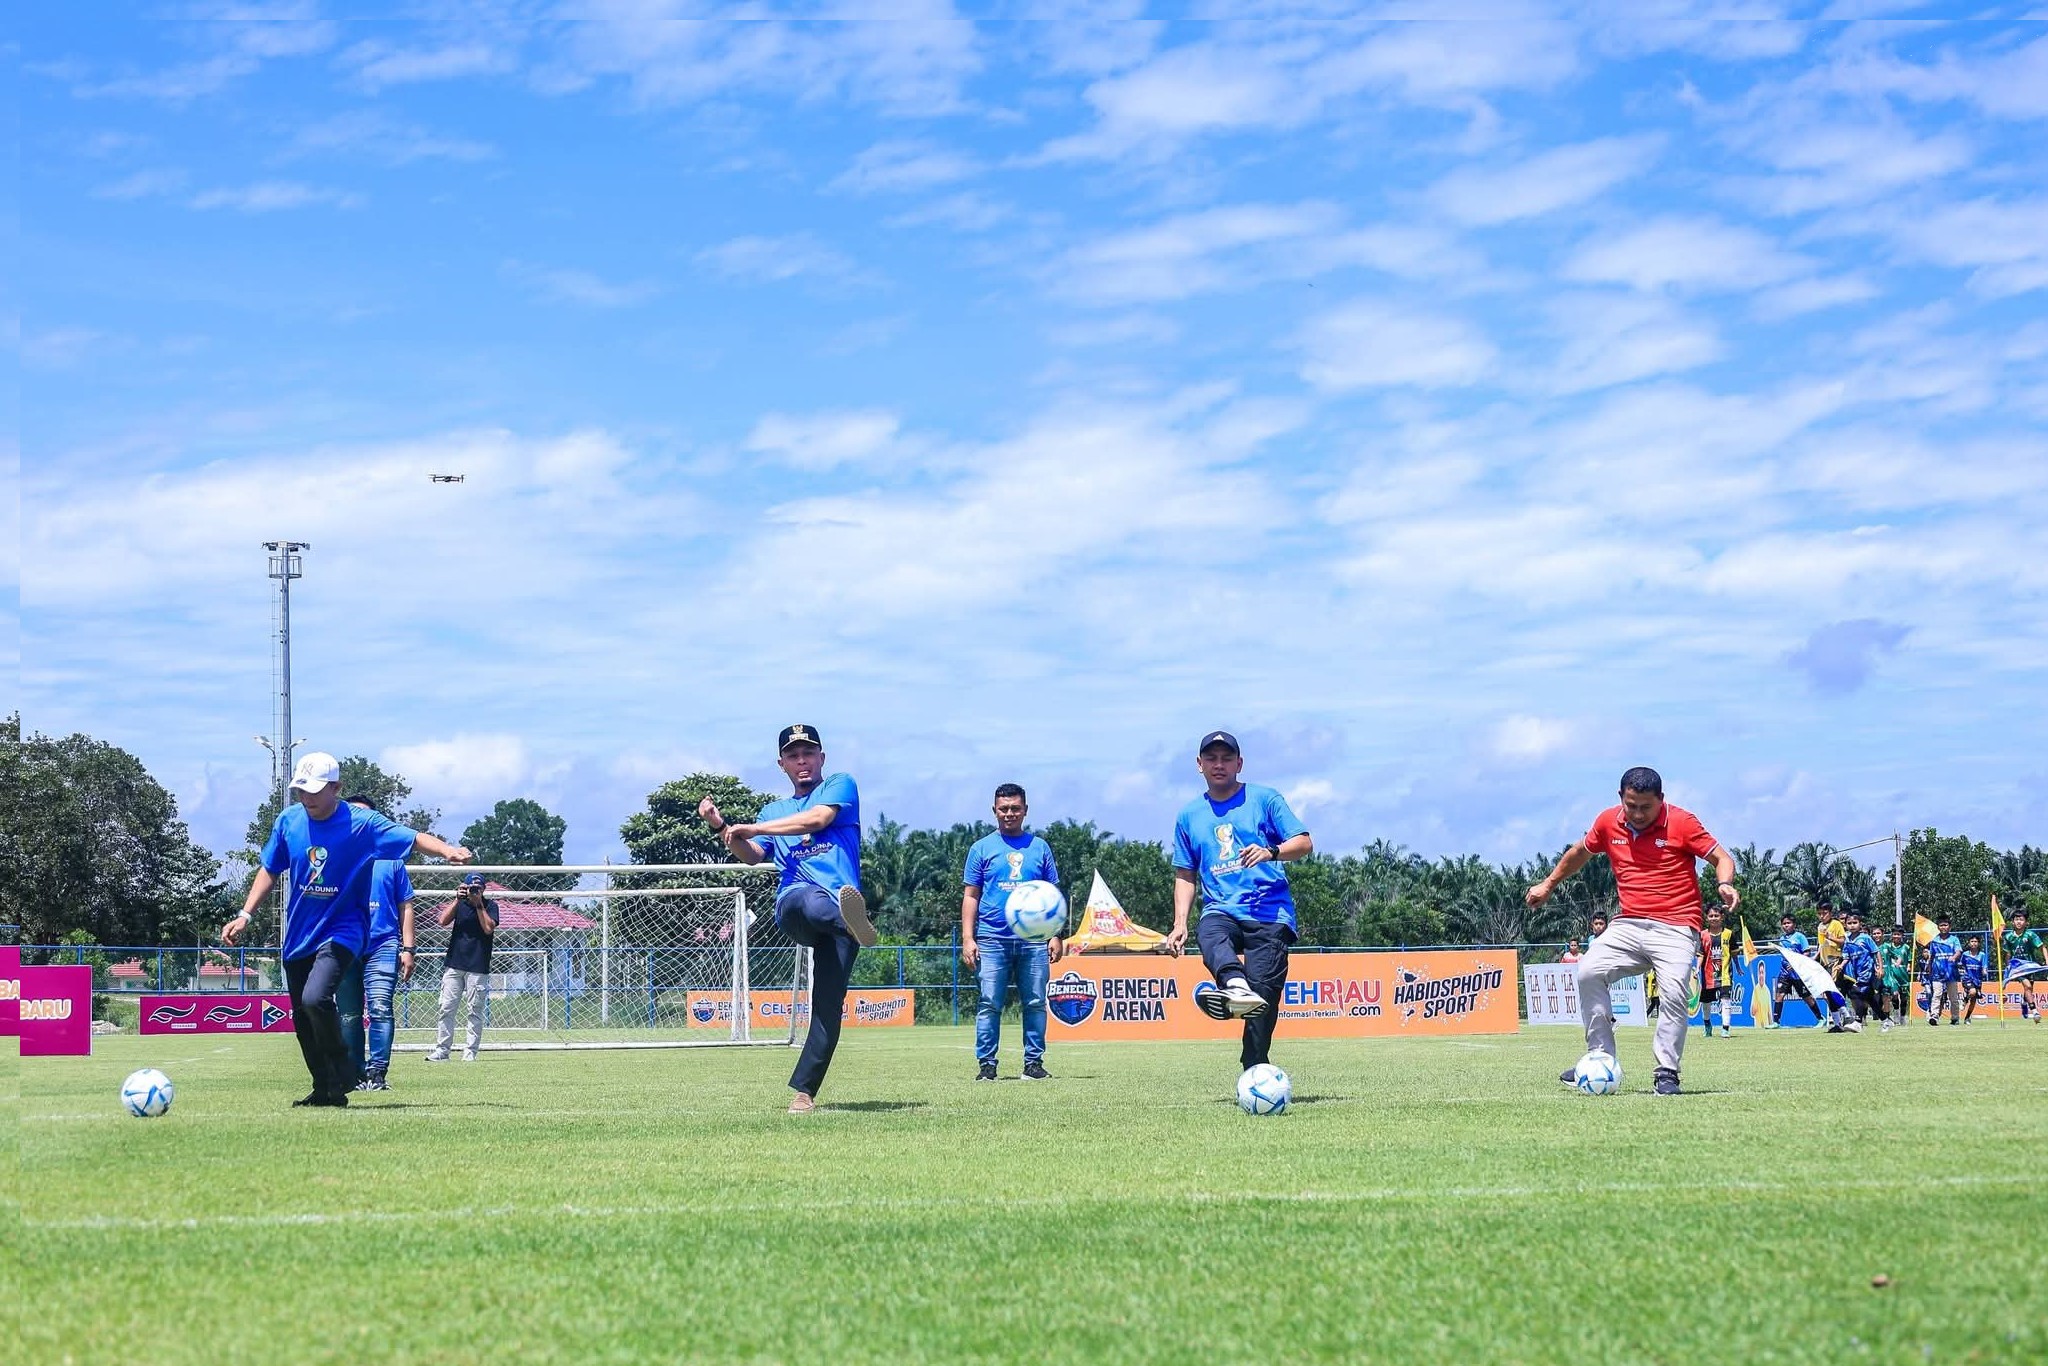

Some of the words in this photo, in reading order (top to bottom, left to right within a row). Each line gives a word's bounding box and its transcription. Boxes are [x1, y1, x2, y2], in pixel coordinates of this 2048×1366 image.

[1048, 984, 1095, 996] BENECIA
[1102, 979, 1178, 998] BENECIA
[1394, 969, 1503, 1005] HABIDSPHOTO
[20, 999, 72, 1020] BARU
[855, 999, 906, 1015] HABIDSPHOTO
[869, 1009, 894, 1021] SPORT
[1102, 1001, 1166, 1021] ARENA
[1348, 1005, 1381, 1016] .com
[1423, 993, 1478, 1018] SPORT
